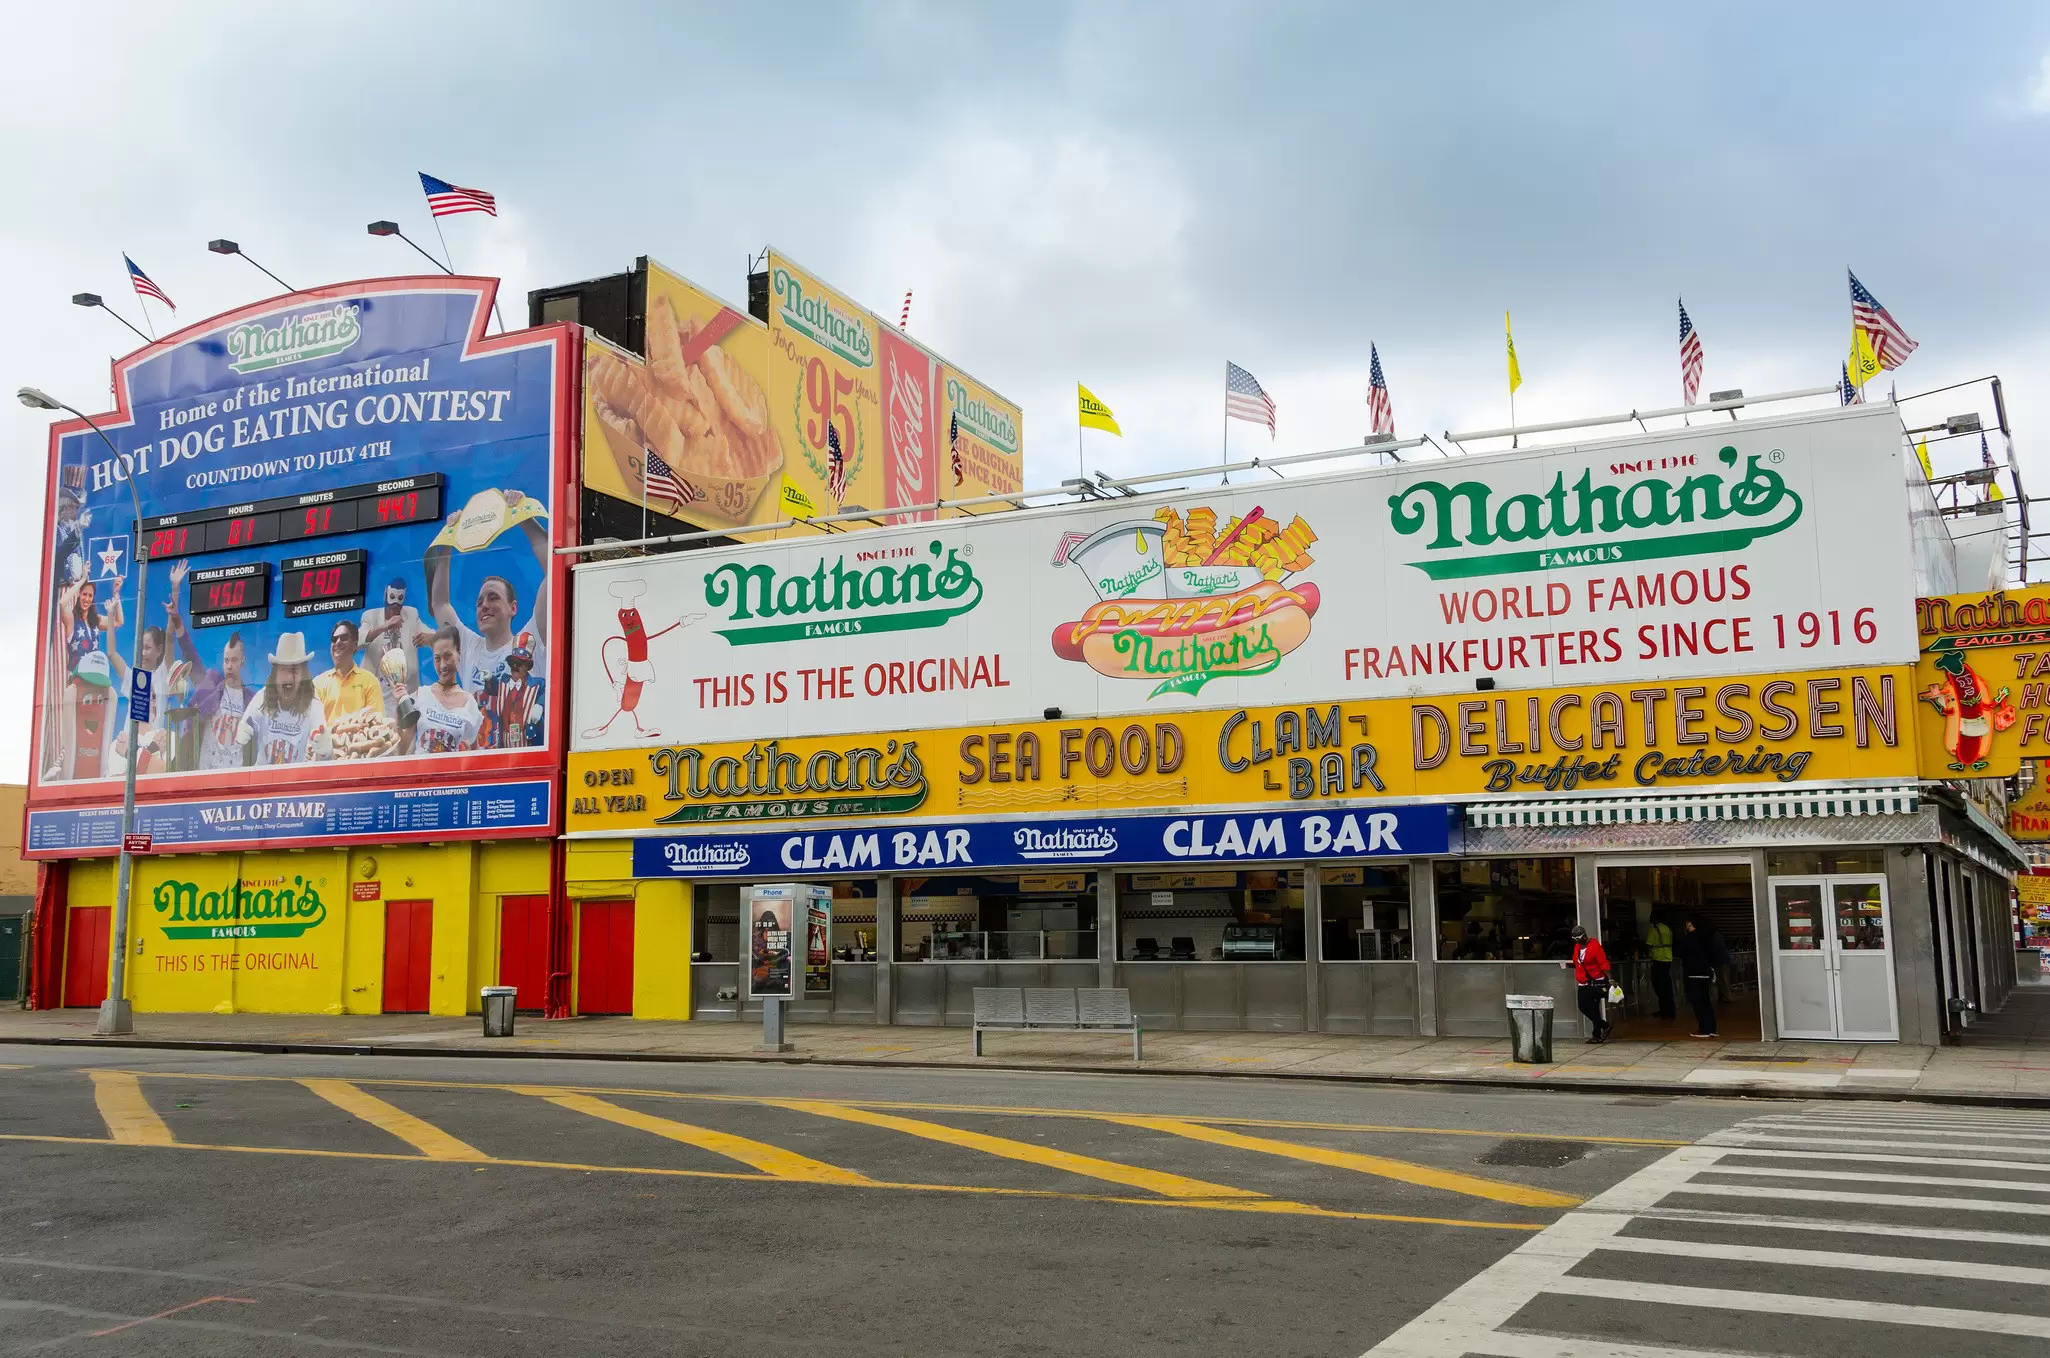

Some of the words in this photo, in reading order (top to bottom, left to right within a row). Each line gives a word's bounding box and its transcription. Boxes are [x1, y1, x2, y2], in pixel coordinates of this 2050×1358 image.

[229, 305, 358, 359] Nathan's
[773, 268, 872, 357] Nathan's
[772, 326, 787, 349] For
[788, 341, 808, 369] Over
[159, 402, 217, 431] Home
[222, 387, 244, 412] of
[249, 383, 280, 407] the
[286, 358, 429, 399] International
[806, 356, 855, 463] 95
[855, 376, 878, 405] Years
[946, 379, 1016, 445] Nathan's
[91, 444, 152, 492] HOT
[159, 424, 225, 468] DOG
[232, 399, 348, 448] EATING
[355, 390, 511, 426] CONTEST
[186, 458, 290, 489] COUNTDOWN
[294, 453, 315, 472] TO
[318, 446, 356, 470] JULY
[359, 440, 392, 460] 4TH
[972, 443, 1021, 483] ORIGINAL
[1609, 457, 1657, 476] SINCE
[1660, 453, 1700, 471] 1916
[160, 516, 178, 526] DAYS
[228, 504, 254, 515] HOURS
[299, 492, 334, 504] MINUTES
[377, 479, 415, 492] SECONDS
[724, 482, 744, 508] 95
[1388, 445, 1790, 551] Nathan's
[150, 528, 188, 556] 281
[293, 559, 314, 567] MALE
[316, 553, 347, 564] RECORD
[856, 548, 889, 562] SINCE
[890, 546, 917, 559] 1916
[1539, 545, 1623, 568] FAMOUS
[197, 570, 224, 580] FEMALE
[225, 566, 255, 577] RECORD
[704, 540, 976, 621] Nathan's
[1099, 558, 1161, 595] Nathan's
[1183, 570, 1240, 587] Nathan's
[292, 605, 312, 614] JOEY
[313, 599, 355, 611] CHESTNUT
[1440, 582, 1572, 625] WORLD
[1589, 564, 1751, 613] FAMOUS
[1916, 591, 2050, 635] Natha
[201, 616, 225, 624] SONYA
[227, 611, 257, 621] THOMAS
[805, 620, 862, 637] FAMOUS
[1112, 623, 1277, 676] Nathan's
[1344, 627, 1623, 681] FRANKFURTERS
[1638, 617, 1754, 661] SINCE
[1773, 606, 1878, 652] 1916
[1954, 632, 2047, 647] FAMOUS
[693, 673, 755, 709] THIS
[765, 671, 788, 704] IS
[797, 666, 855, 701] THE
[864, 654, 1011, 697] ORIGINAL
[1169, 673, 1207, 688] FAMOUS
[1218, 705, 1342, 773] CLAM
[1411, 674, 1899, 770] DELICATESSEN
[648, 739, 924, 800] Nathan's
[959, 731, 1041, 784] SEA
[1059, 722, 1185, 780] FOOD
[1288, 742, 1386, 800] BAR
[1481, 752, 1622, 792] Buffet
[1634, 744, 1812, 785] Catering
[433, 788, 468, 796] CHAMPIONS
[584, 768, 634, 787] OPEN
[200, 805, 245, 824] WALL
[249, 803, 272, 819] OF
[276, 802, 325, 818] FAME
[572, 797, 601, 814] ALL
[604, 795, 646, 812] YEAR
[707, 801, 829, 818] FAMOUS
[664, 841, 748, 864] Nathan's
[780, 833, 881, 870] CLAM
[892, 828, 973, 867] BAR
[1013, 826, 1116, 850] Nathan's
[1162, 817, 1287, 857] CLAM
[1300, 812, 1402, 853] BAR
[153, 875, 322, 922] Nathan's
[241, 879, 261, 888] SINCE
[211, 925, 257, 938] FAMOUS
[156, 955, 188, 972] THIS
[193, 954, 205, 971] IS
[211, 953, 240, 971] THE
[245, 952, 319, 970] ORIGINAL
